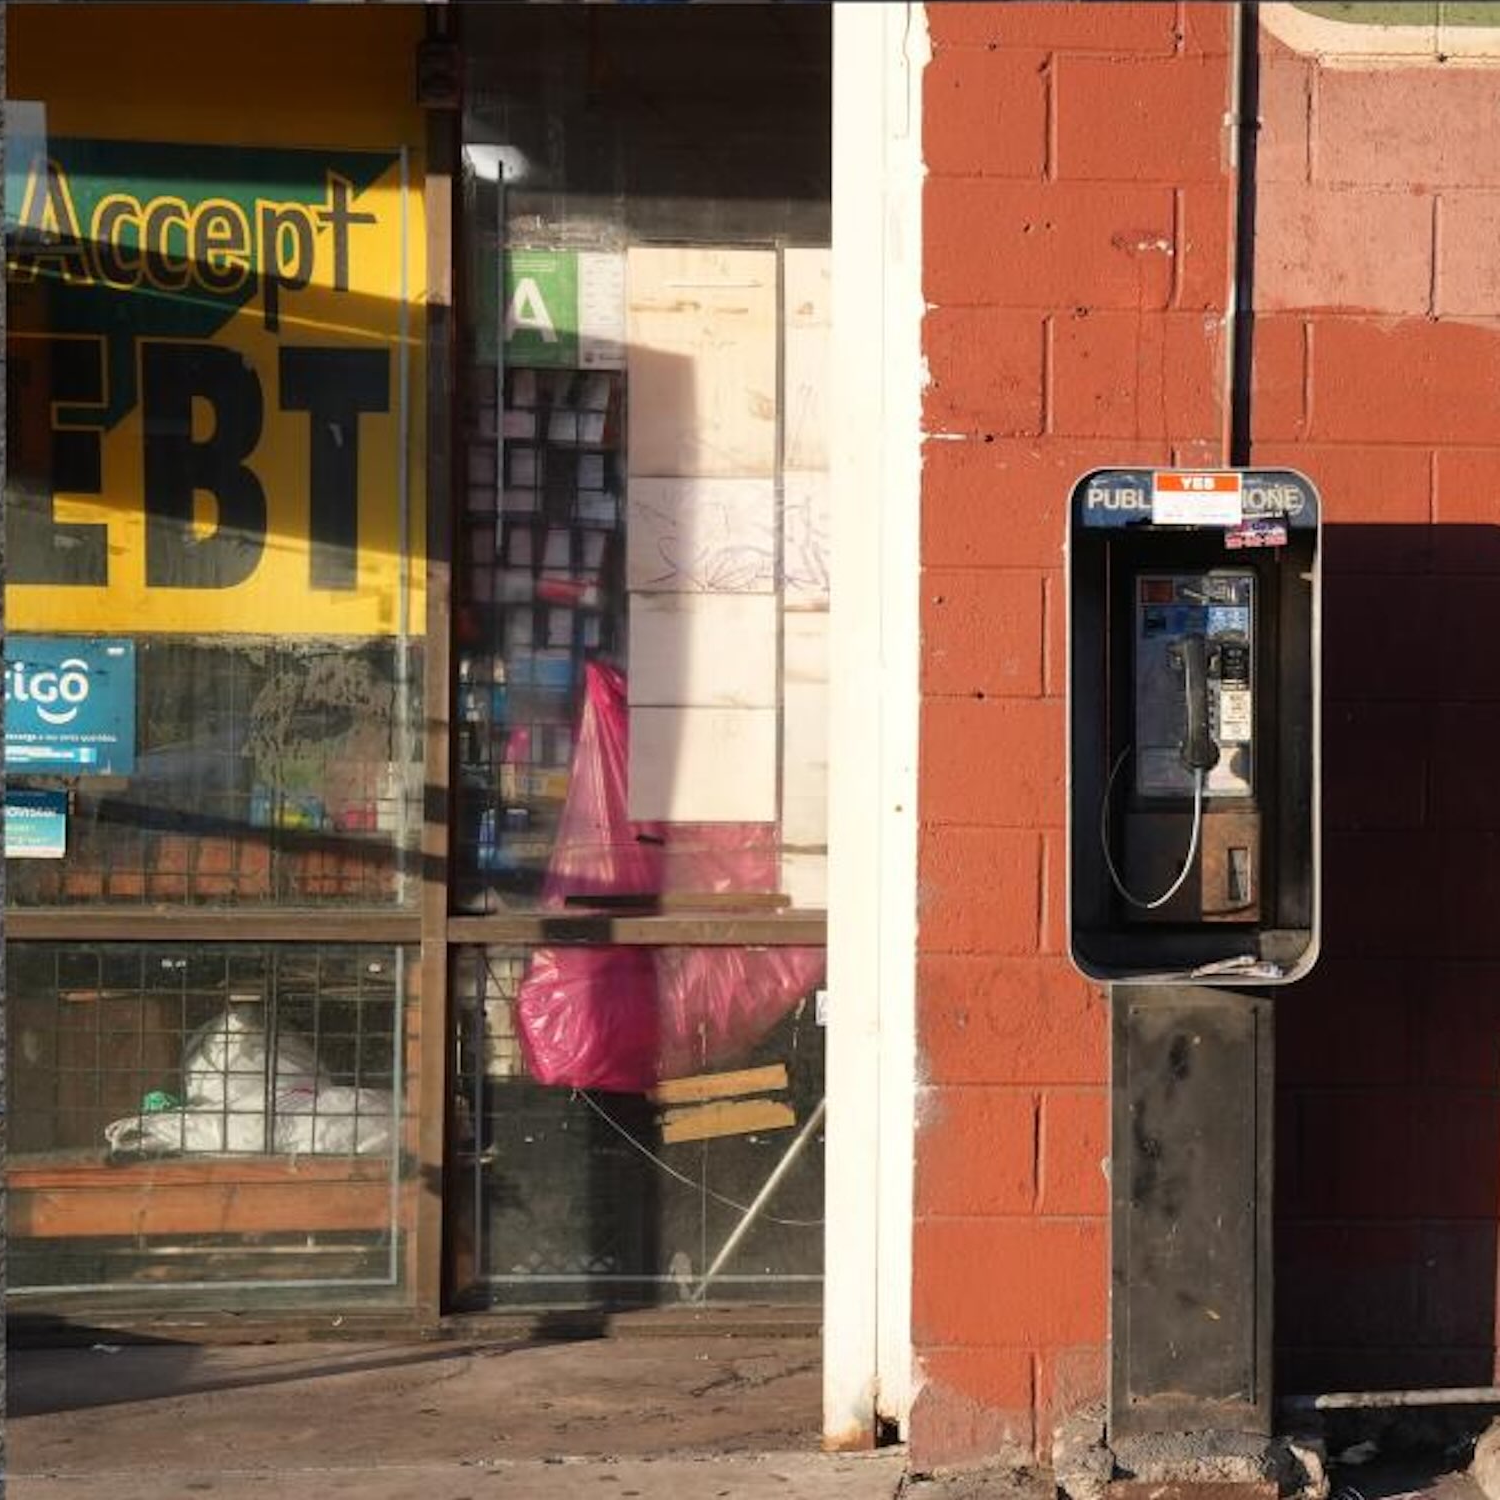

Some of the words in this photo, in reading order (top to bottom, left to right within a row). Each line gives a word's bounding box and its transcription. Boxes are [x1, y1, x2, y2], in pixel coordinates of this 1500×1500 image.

[7, 160, 376, 334] Accept
[508, 277, 558, 342] A
[6, 336, 390, 591] EBT
[1180, 477, 1216, 491] YES
[1087, 488, 1152, 509] PUBL
[1243, 486, 1300, 509] ONE
